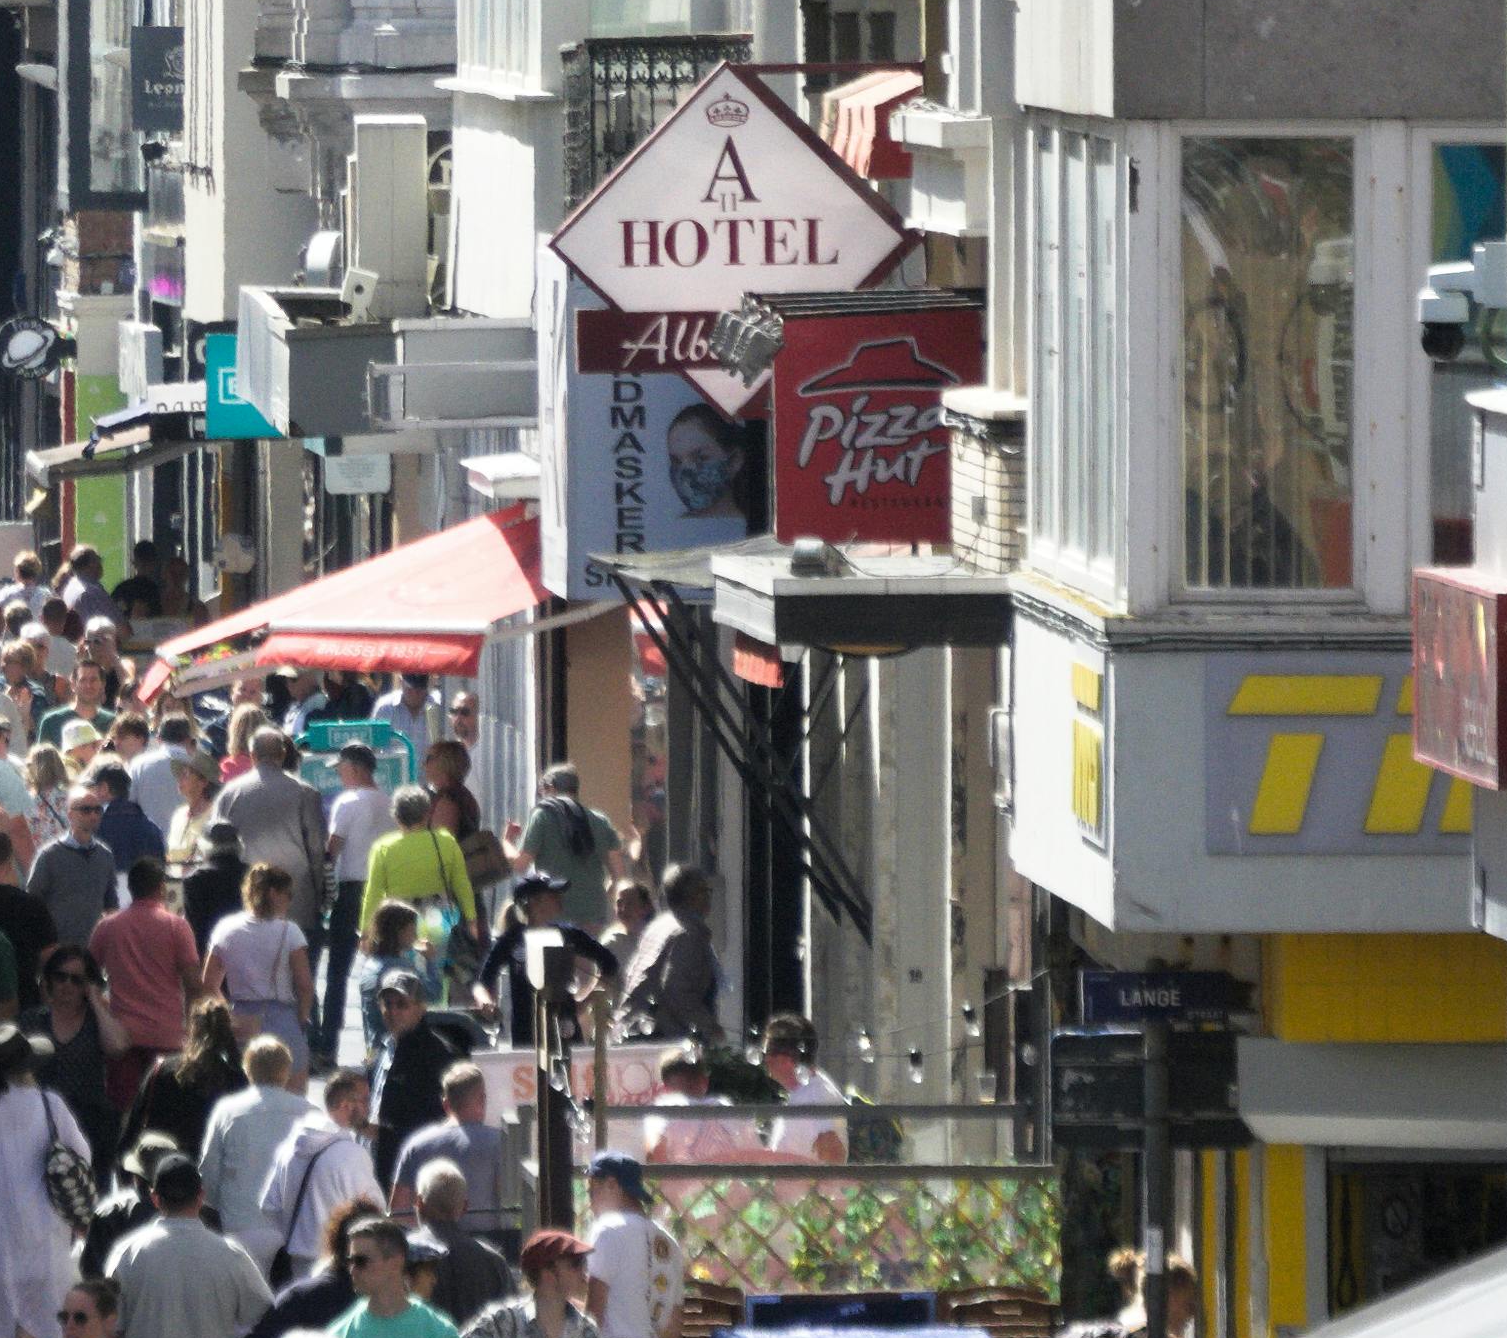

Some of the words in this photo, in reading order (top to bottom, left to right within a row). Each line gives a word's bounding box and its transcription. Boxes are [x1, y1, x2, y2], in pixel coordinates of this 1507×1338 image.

[699, 135, 761, 204] A
[617, 217, 840, 270] HOTEL
[620, 314, 720, 368] Alb
[609, 372, 648, 555] DMASKER
[824, 441, 949, 509] Hut
[315, 642, 386, 658] BRUSSELS
[1120, 989, 1182, 1007] LANGE
